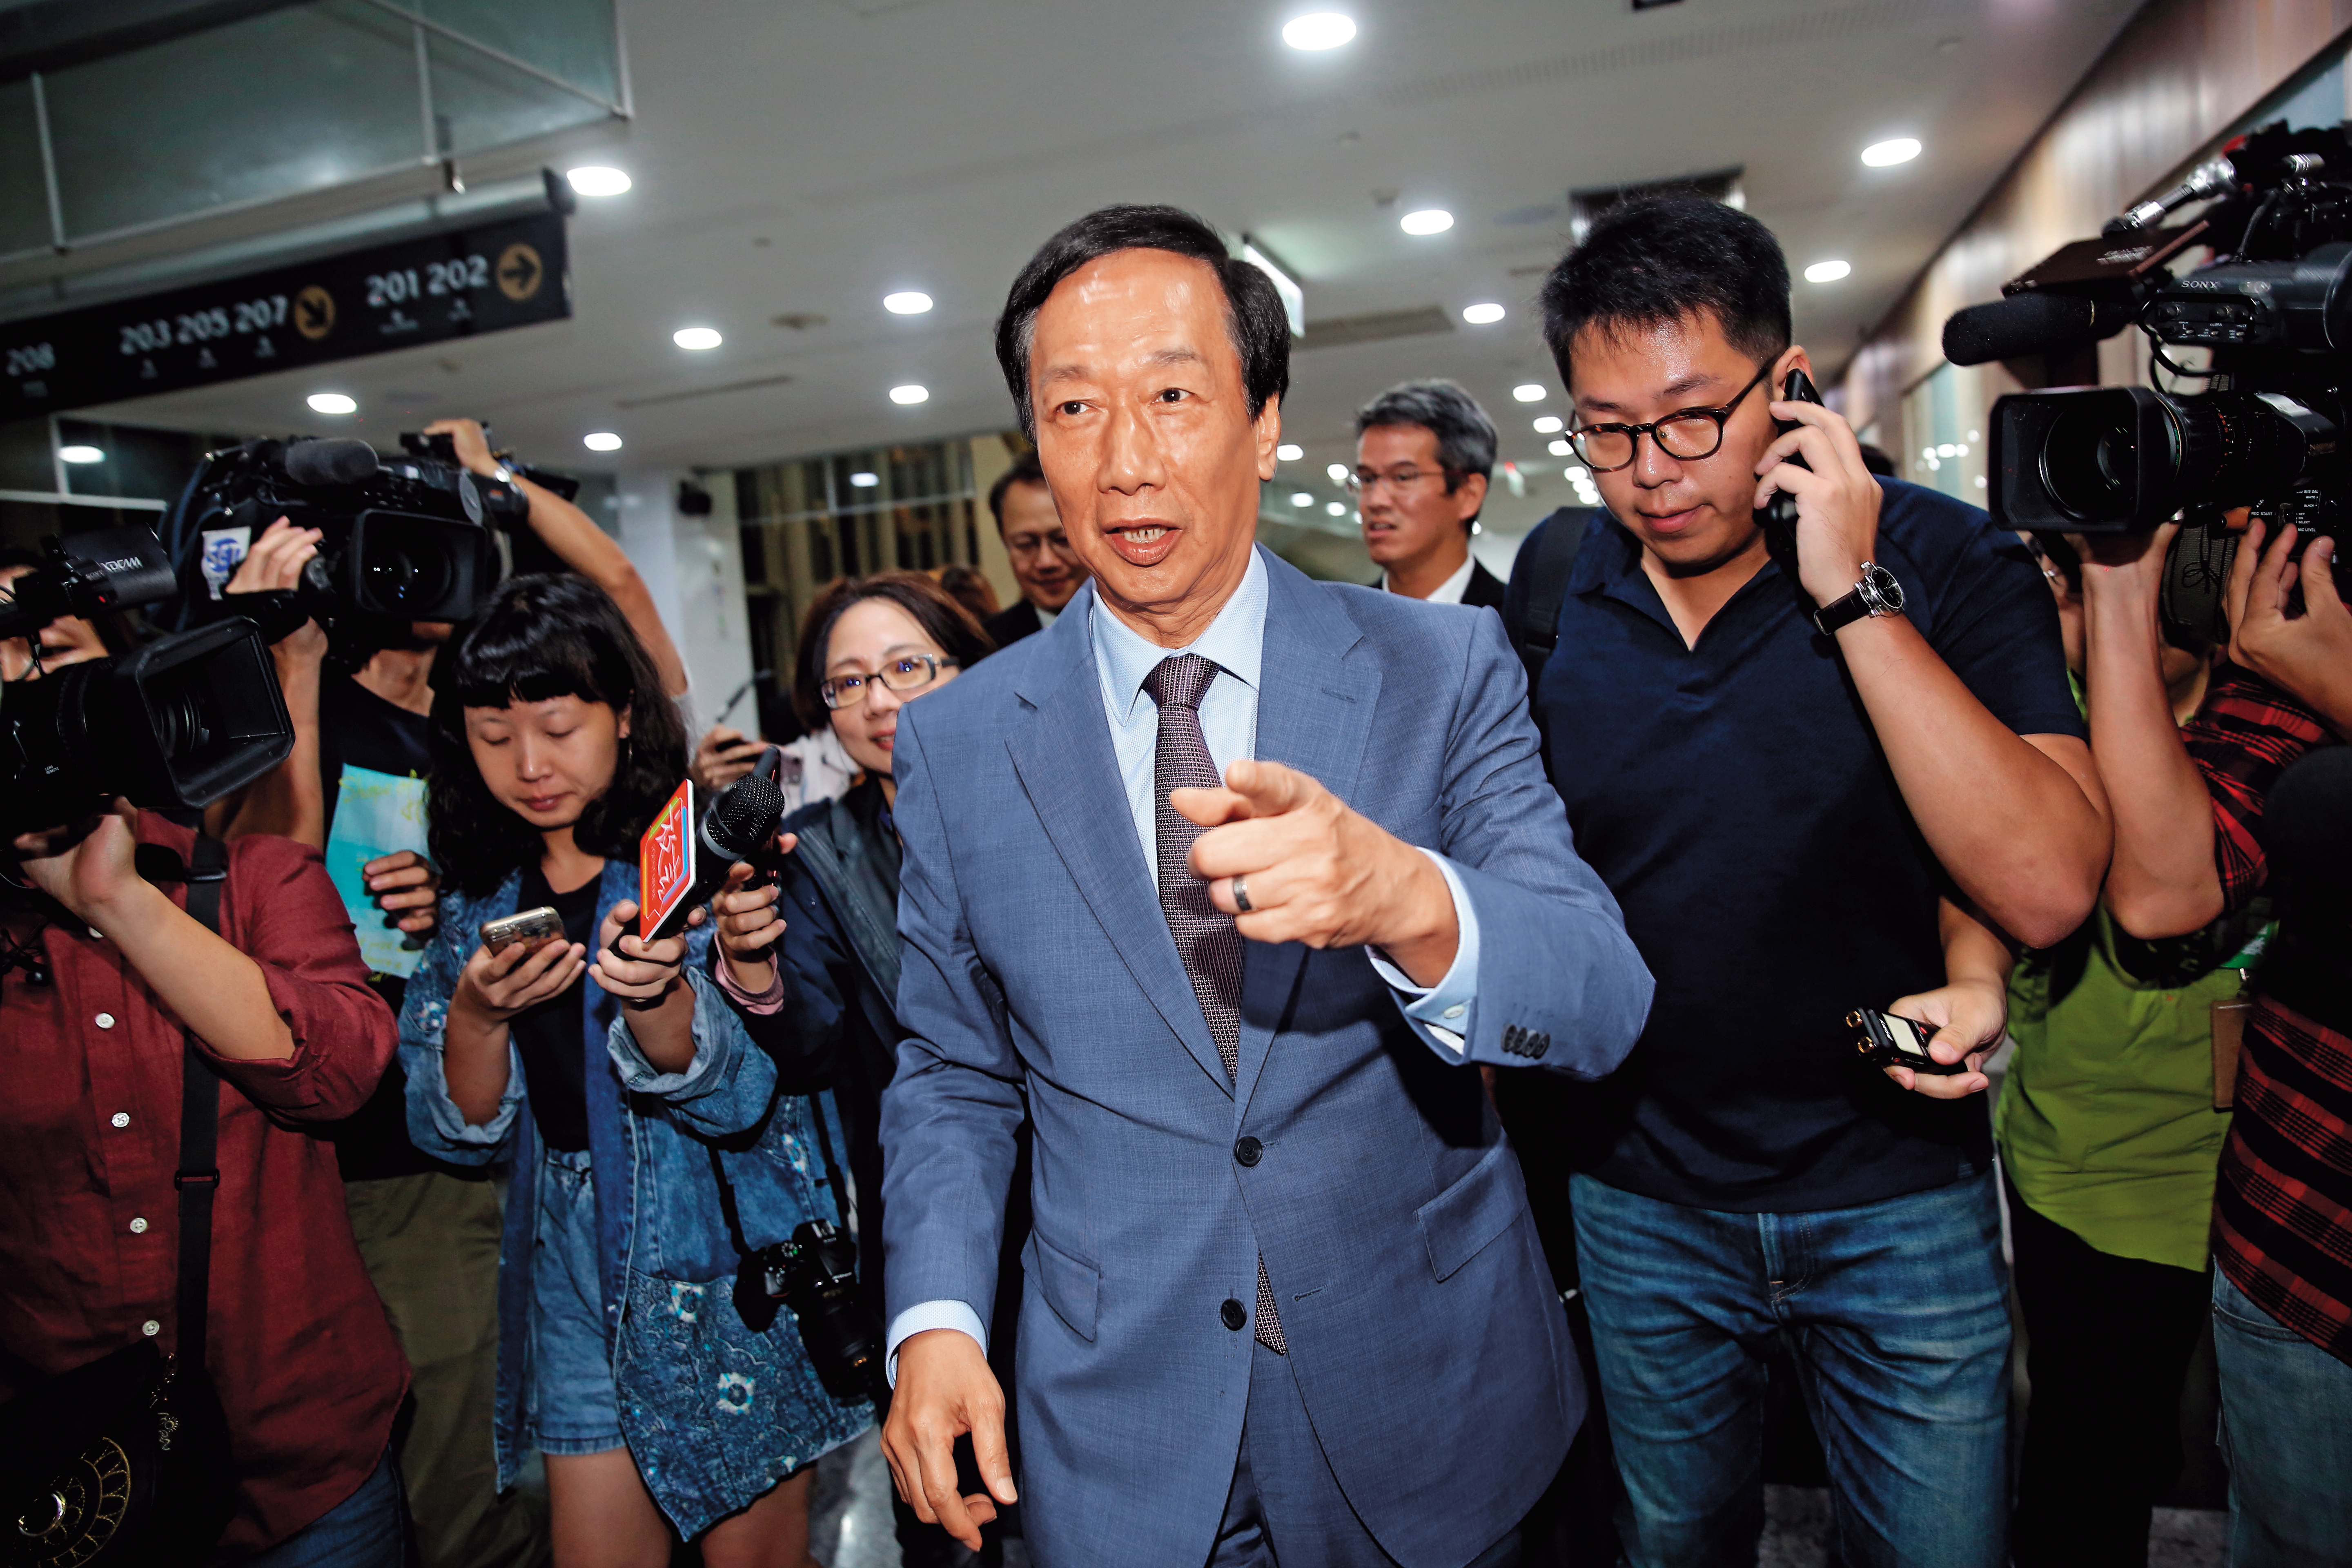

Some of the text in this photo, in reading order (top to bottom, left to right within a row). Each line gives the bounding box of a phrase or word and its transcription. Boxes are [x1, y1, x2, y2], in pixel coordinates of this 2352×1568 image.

[366, 255, 488, 307] 201 202
[2181, 281, 2219, 289] SONY
[234, 294, 287, 333] 207
[100, 557, 143, 573] XDCAM
[46, 766, 59, 775] REMOTE
[1878, 1018, 1894, 1041] SONY
